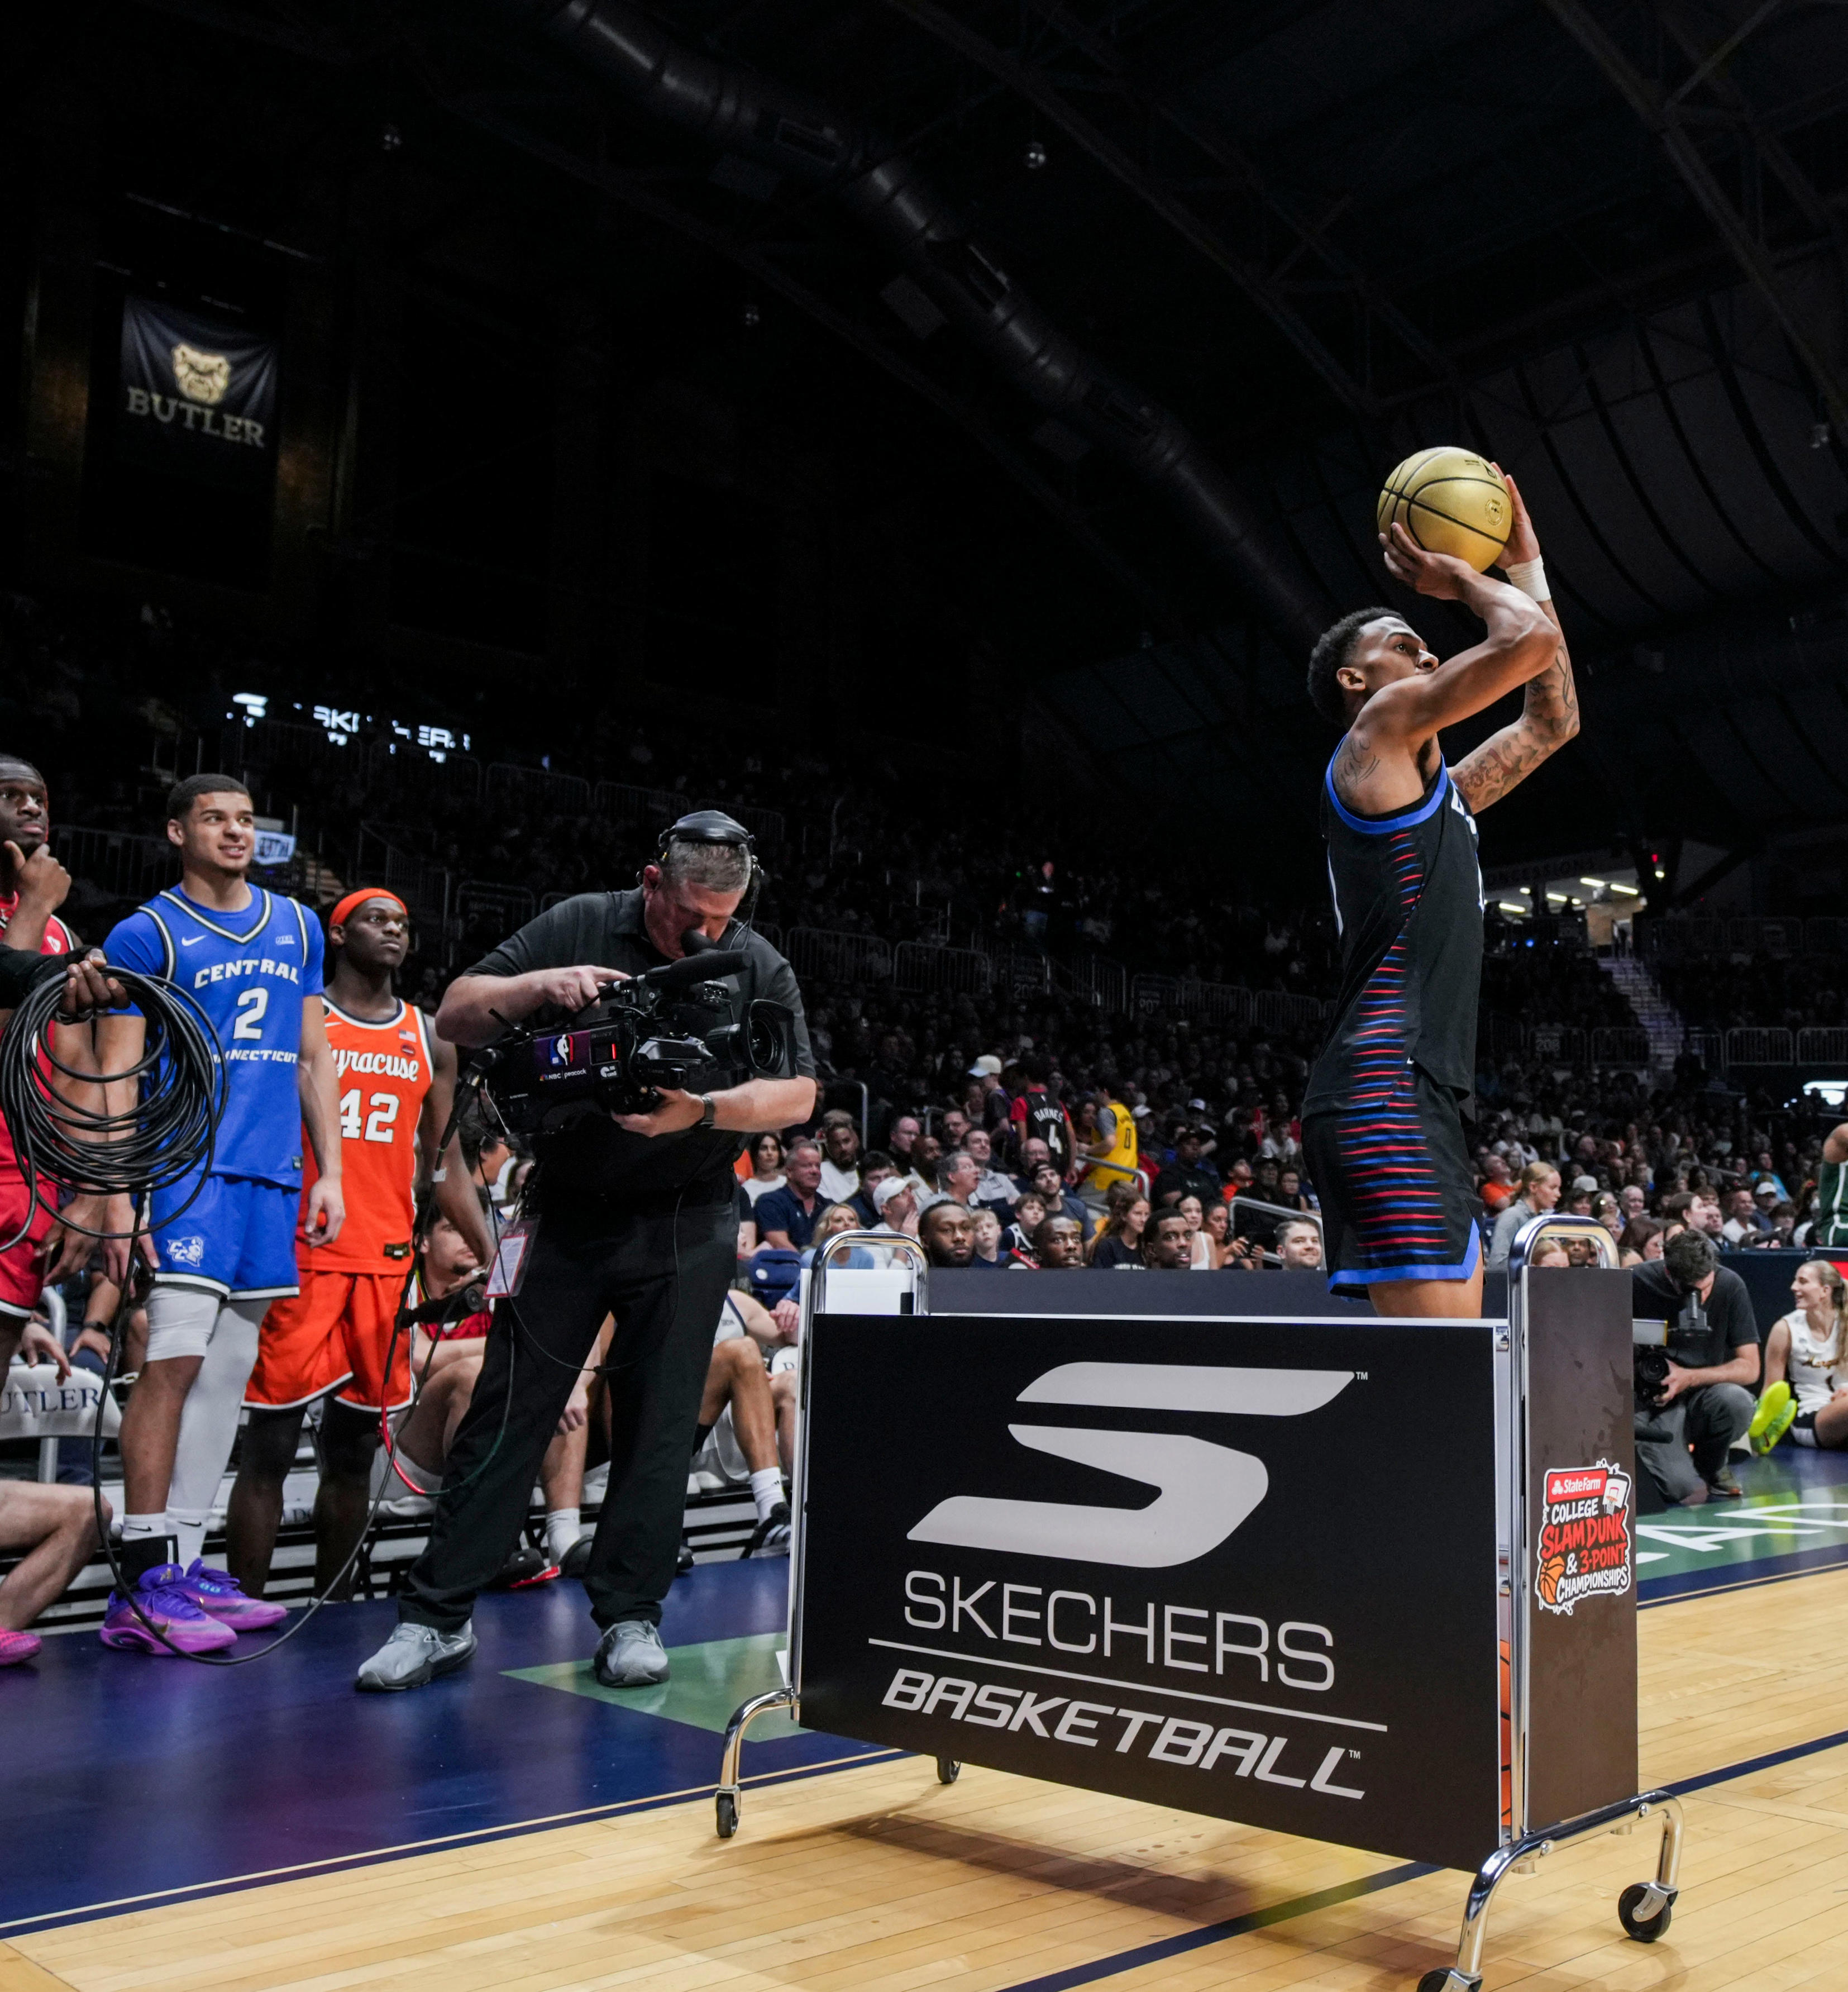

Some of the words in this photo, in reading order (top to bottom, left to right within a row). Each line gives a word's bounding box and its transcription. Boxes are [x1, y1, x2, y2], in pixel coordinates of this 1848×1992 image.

[127, 386, 264, 447] BUTLER
[1486, 858, 1594, 886] ONCESSIONS
[194, 959, 299, 989] CENTRAL
[233, 987, 269, 1040] 2
[328, 1042, 419, 1082] yracuse
[564, 1068, 586, 1080] peacock
[340, 1089, 399, 1143] 42
[1034, 1108, 1063, 1123] BARNES
[1049, 1124, 1062, 1154] 4
[0, 1387, 99, 1414] UTLER
[1551, 1498, 1599, 1525] COLLEGE
[1541, 1520, 1586, 1560] SLAM
[1586, 1509, 1627, 1548] DUNK
[1566, 1553, 1578, 1575] &
[1580, 1542, 1627, 1574] 3-POINT
[1556, 1566, 1629, 1603] CHAMPIONSHIPS
[904, 1570, 1335, 1691] SKECHERS
[881, 1668, 1365, 1800] BASKETBALL
